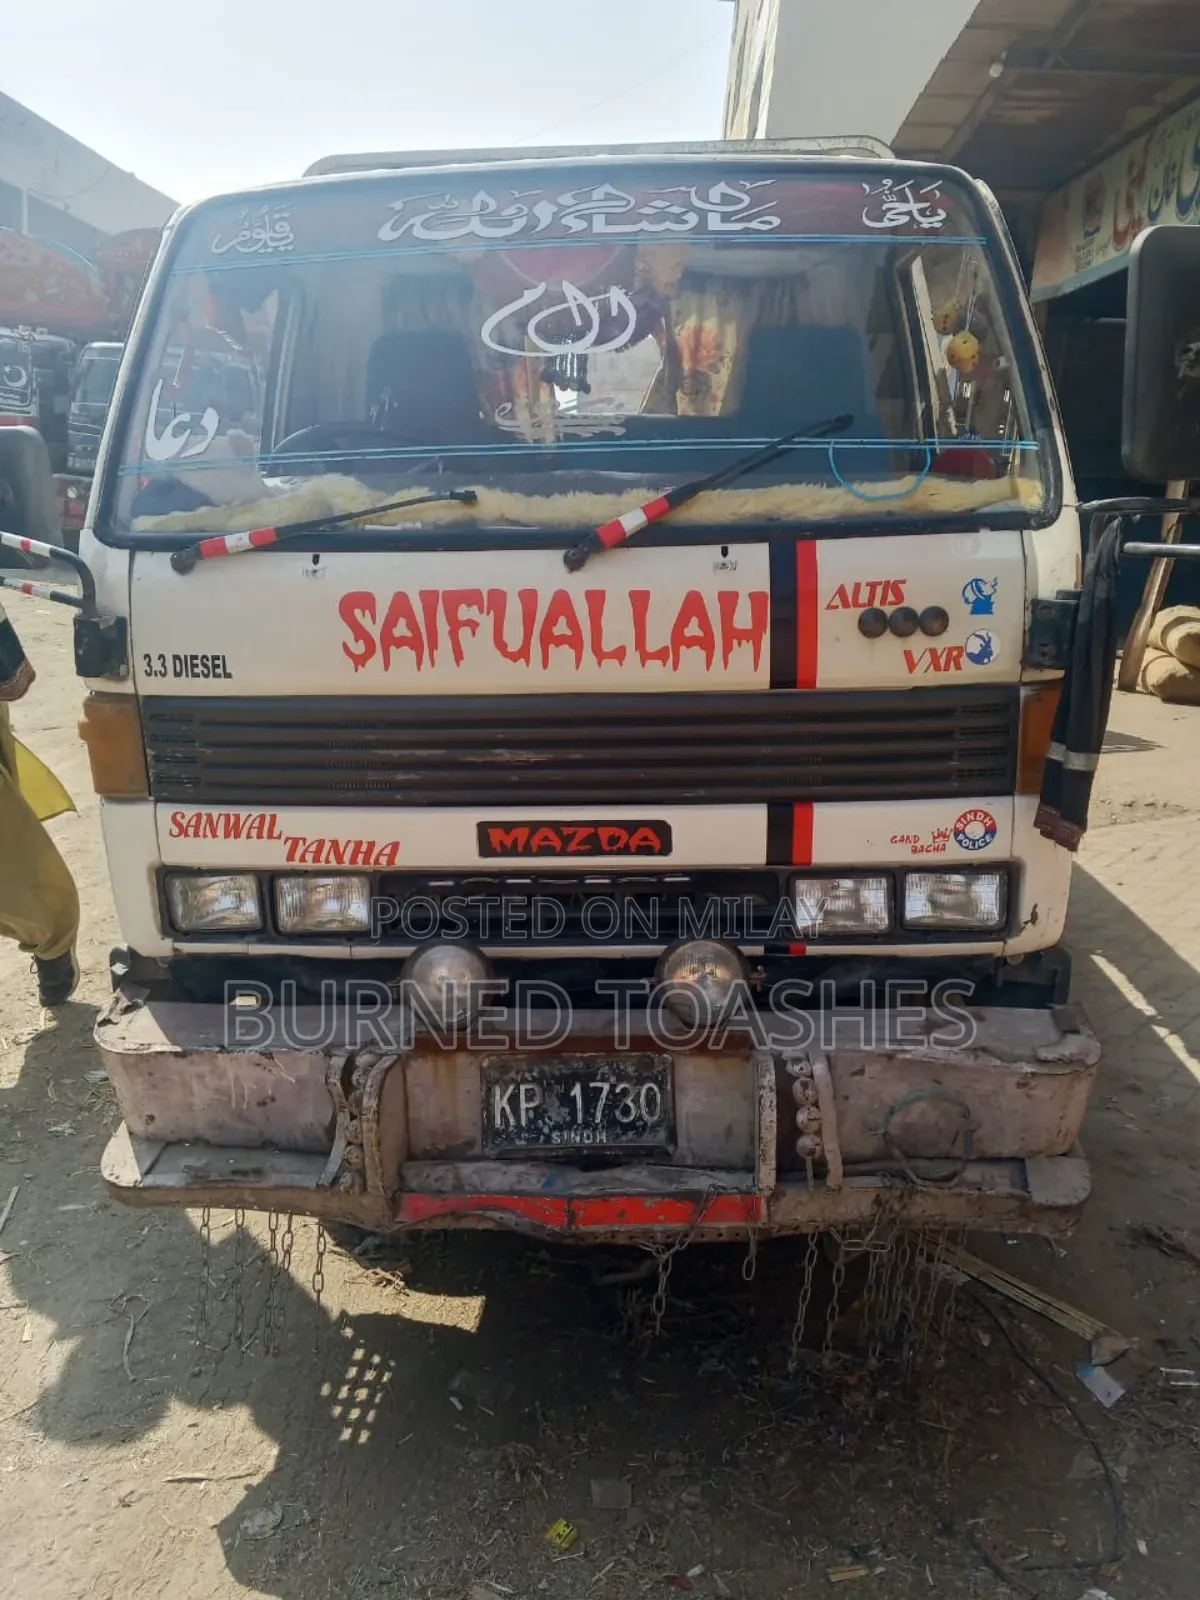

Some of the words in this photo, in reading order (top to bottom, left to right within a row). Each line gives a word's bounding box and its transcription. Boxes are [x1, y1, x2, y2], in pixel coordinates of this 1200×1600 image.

[825, 579, 907, 611] ALTIS
[338, 589, 769, 673] SAIFUALLAH
[143, 654, 169, 678] 3.3
[172, 654, 233, 679] DIESEL
[904, 645, 964, 675] VXR
[169, 810, 283, 840] SANWAL
[956, 812, 993, 831] SINDH
[283, 836, 400, 866] TANHA
[487, 826, 662, 854] MAZDA
[957, 833, 992, 849] POLICE
[569, 1081, 662, 1127] 1730
